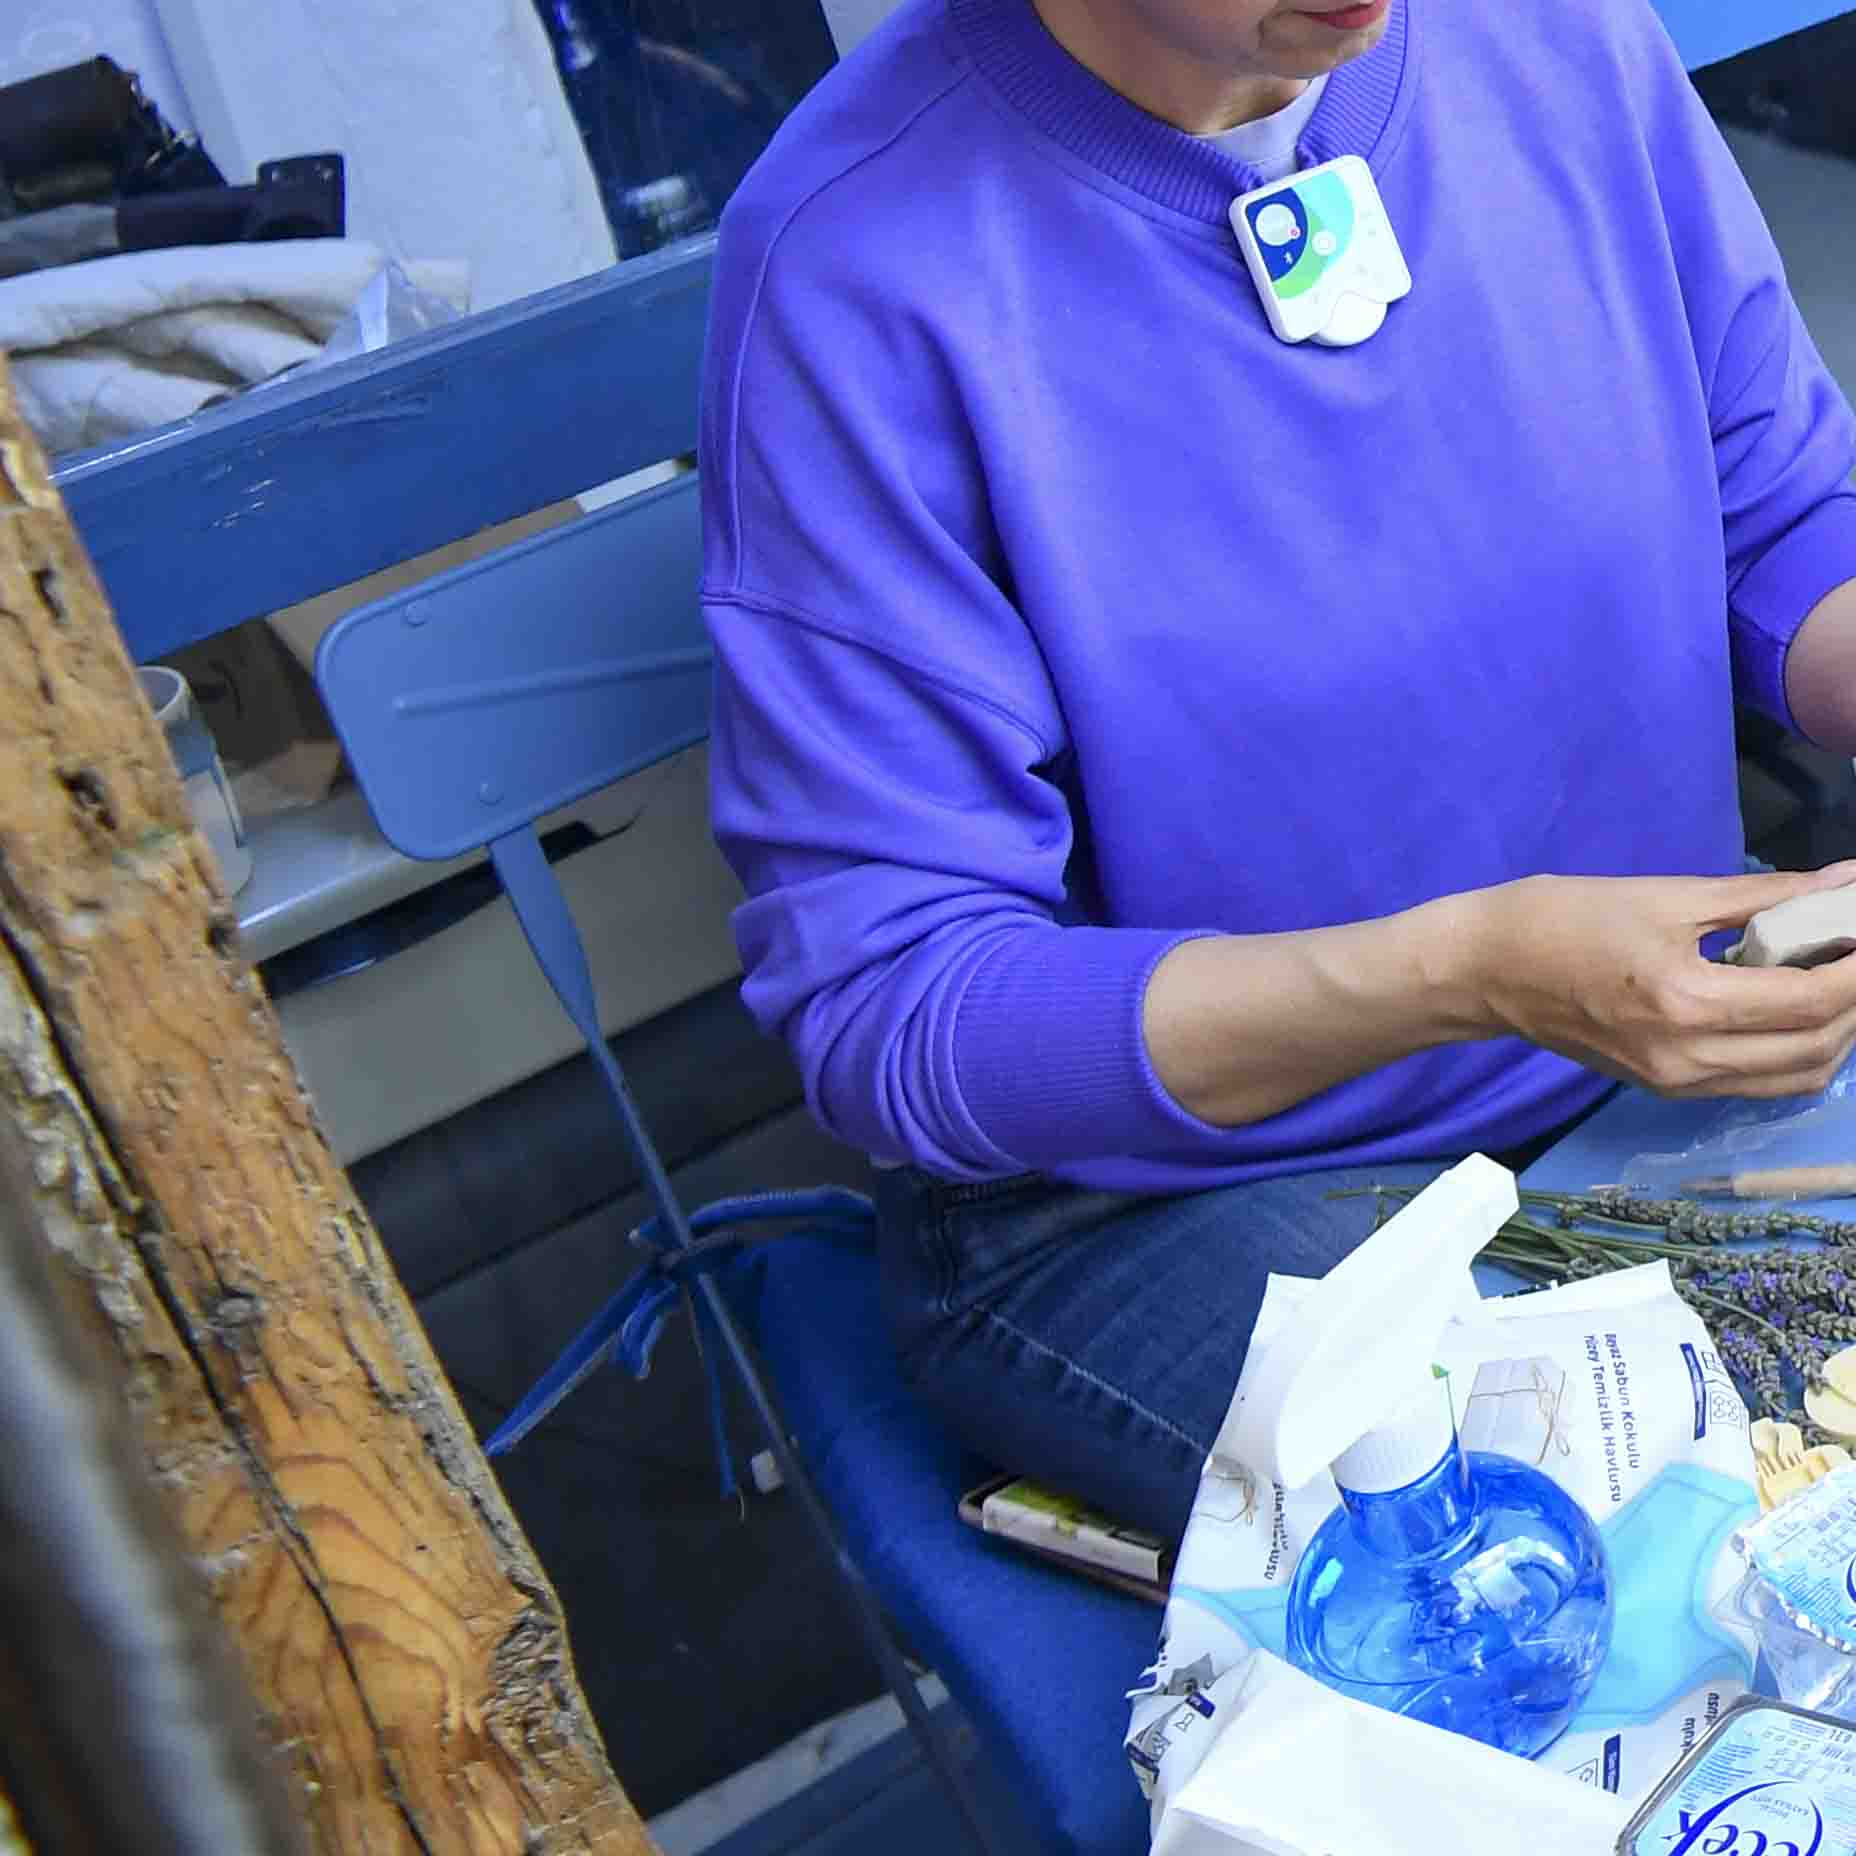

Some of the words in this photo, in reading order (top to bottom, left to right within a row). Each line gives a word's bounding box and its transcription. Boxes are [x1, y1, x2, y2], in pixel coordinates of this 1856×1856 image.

[1592, 1365, 1615, 1431] Temizlik
[1613, 1361, 1630, 1406] Sabun
[1603, 1437, 1622, 1502] Havlusu
[1621, 1410, 1640, 1469] Kokulu
